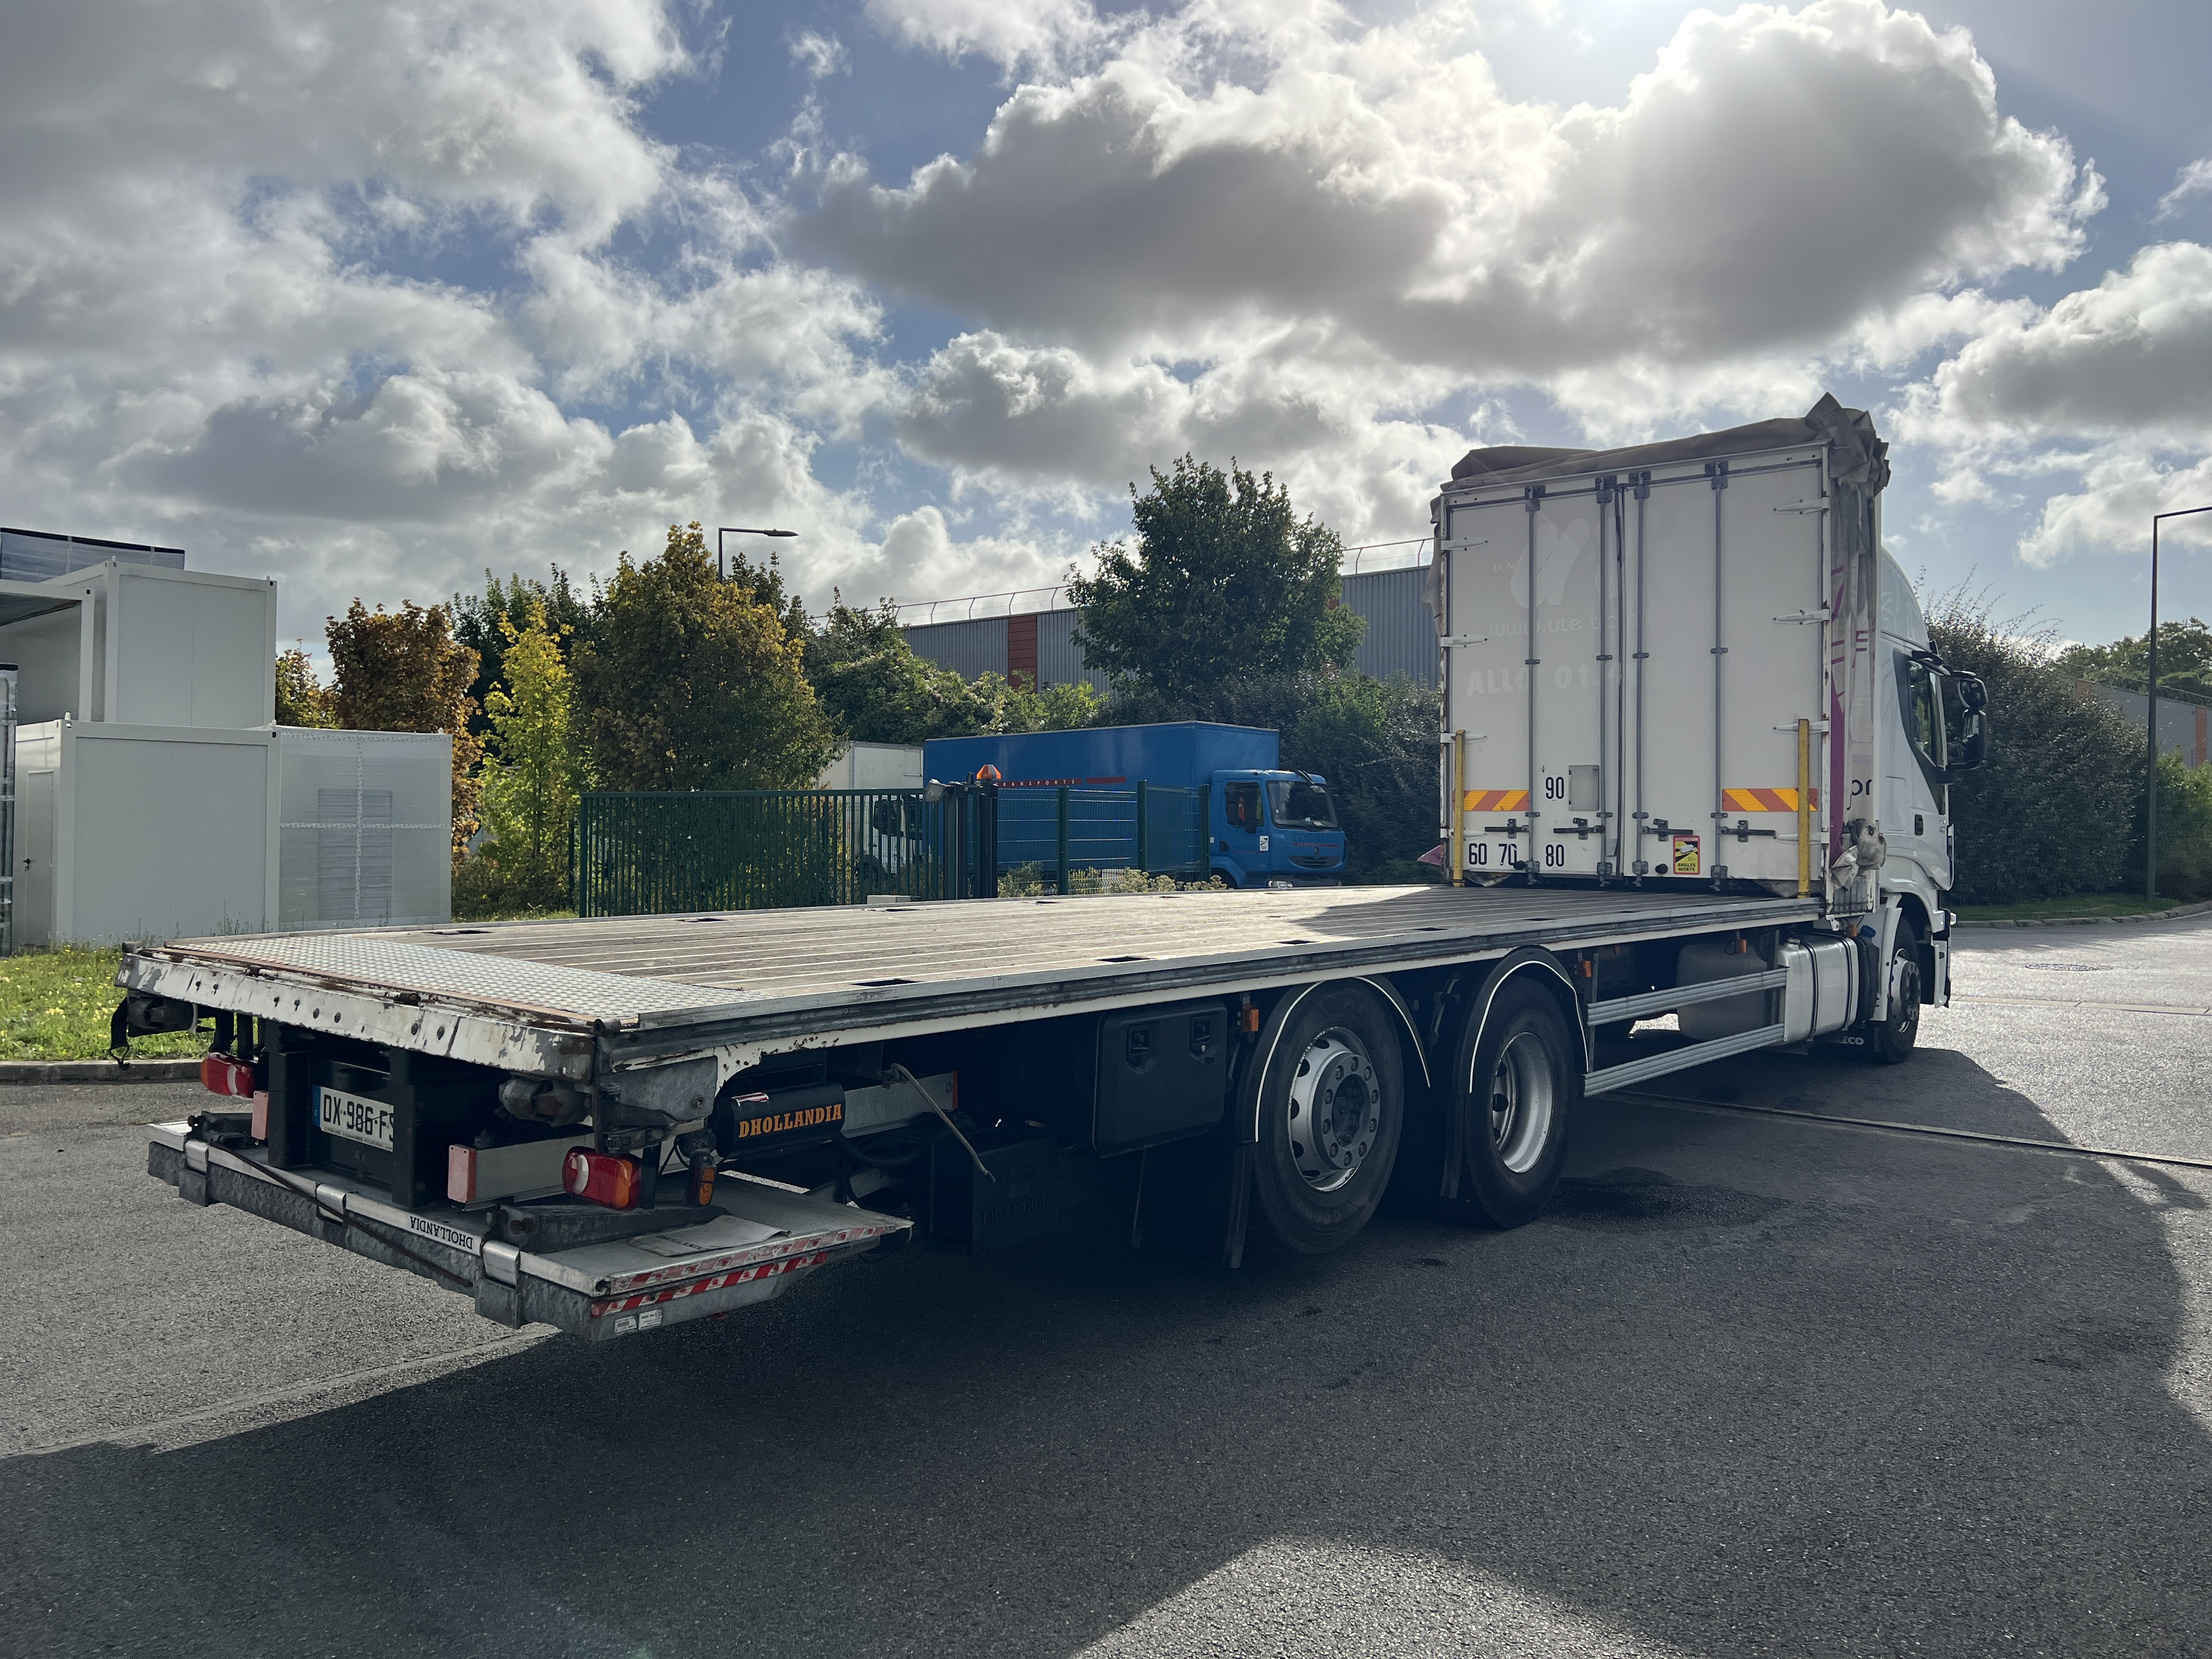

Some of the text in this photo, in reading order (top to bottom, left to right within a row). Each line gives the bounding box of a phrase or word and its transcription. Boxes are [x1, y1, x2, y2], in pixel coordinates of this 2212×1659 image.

[1545, 776, 1564, 799] 90
[1469, 843, 1487, 865] 60
[1498, 843, 1517, 866] 70
[1545, 844, 1564, 867] 80
[738, 1103, 842, 1138] DHOLLANDIA
[410, 1216, 473, 1250] DHOLLANDIA
